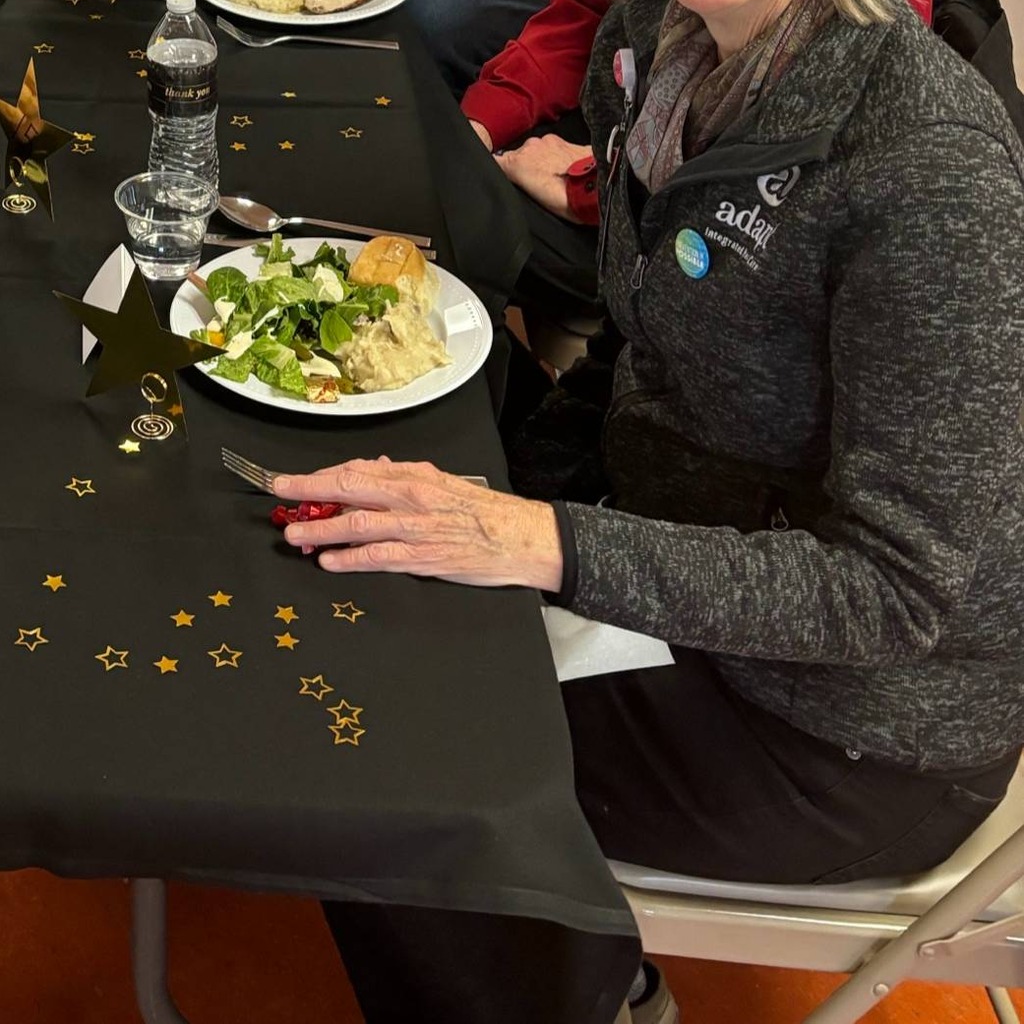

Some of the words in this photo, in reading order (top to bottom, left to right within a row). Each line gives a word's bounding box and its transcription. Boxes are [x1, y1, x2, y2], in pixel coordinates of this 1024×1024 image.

[165, 86, 195, 99] thank
[195, 86, 211, 103] you
[704, 226, 745, 257] Integrated
